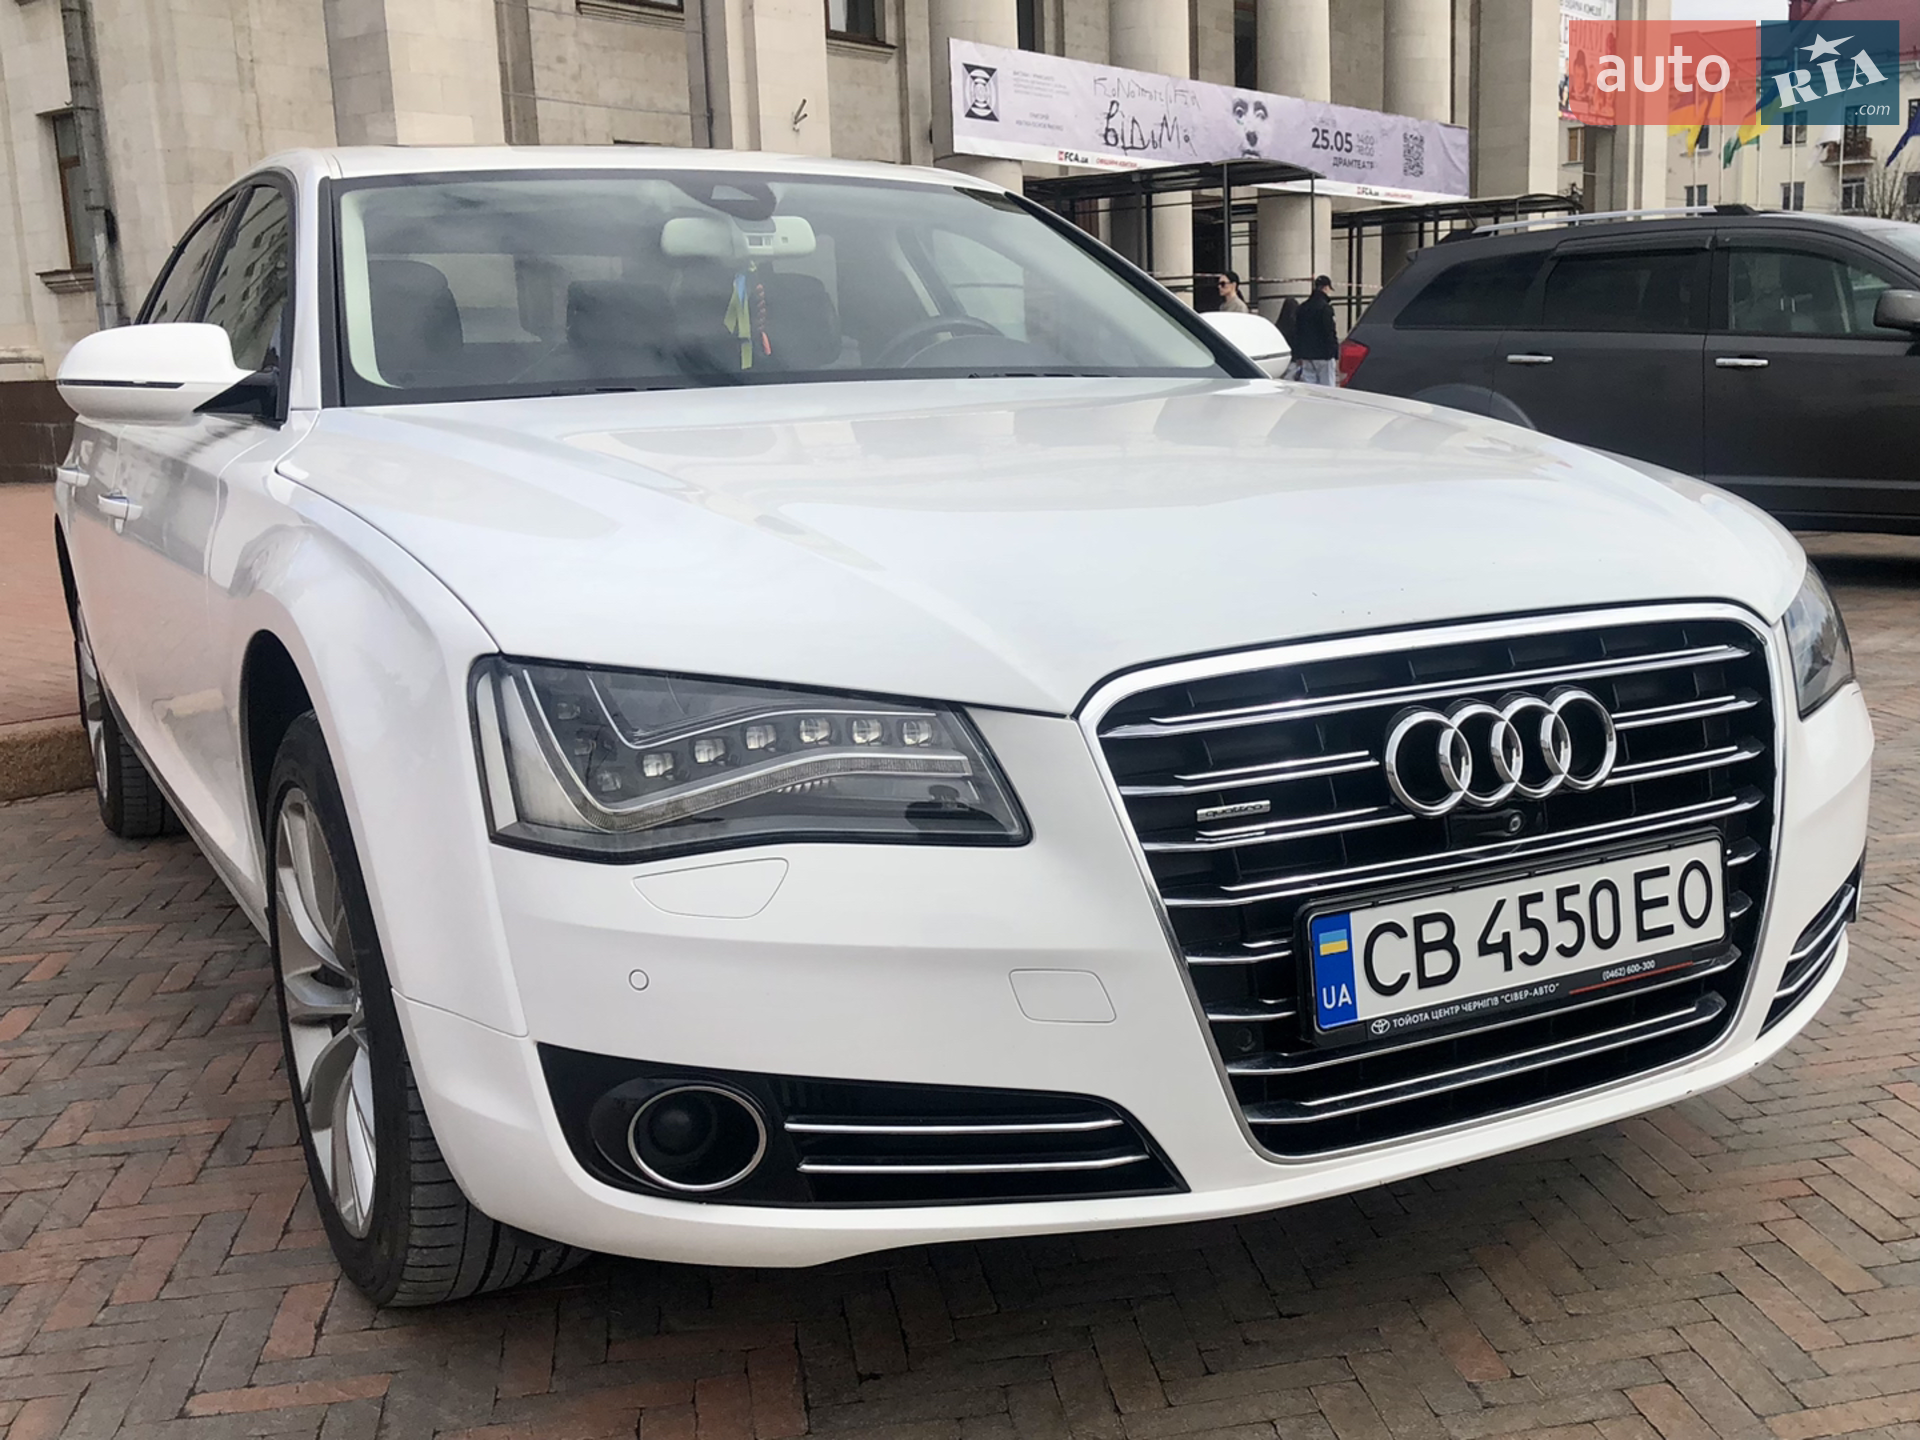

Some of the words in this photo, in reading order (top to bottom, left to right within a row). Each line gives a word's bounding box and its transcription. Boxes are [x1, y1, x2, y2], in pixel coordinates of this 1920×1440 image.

[1311, 127, 1353, 153] 25.05
[1206, 804, 1263, 817] quattro
[1363, 912, 1461, 997] CB
[1477, 878, 1621, 973] 4550
[1634, 860, 1713, 943] EO
[1602, 967, 1626, 981] (0462)
[1626, 960, 1656, 975] 600-300
[1322, 986, 1352, 1010] UA
[1393, 1012, 1430, 1028] ТОЙОТА
[1431, 1005, 1460, 1020] ЦЕНТР
[1461, 995, 1499, 1013] ЧЕРНІГІВ
